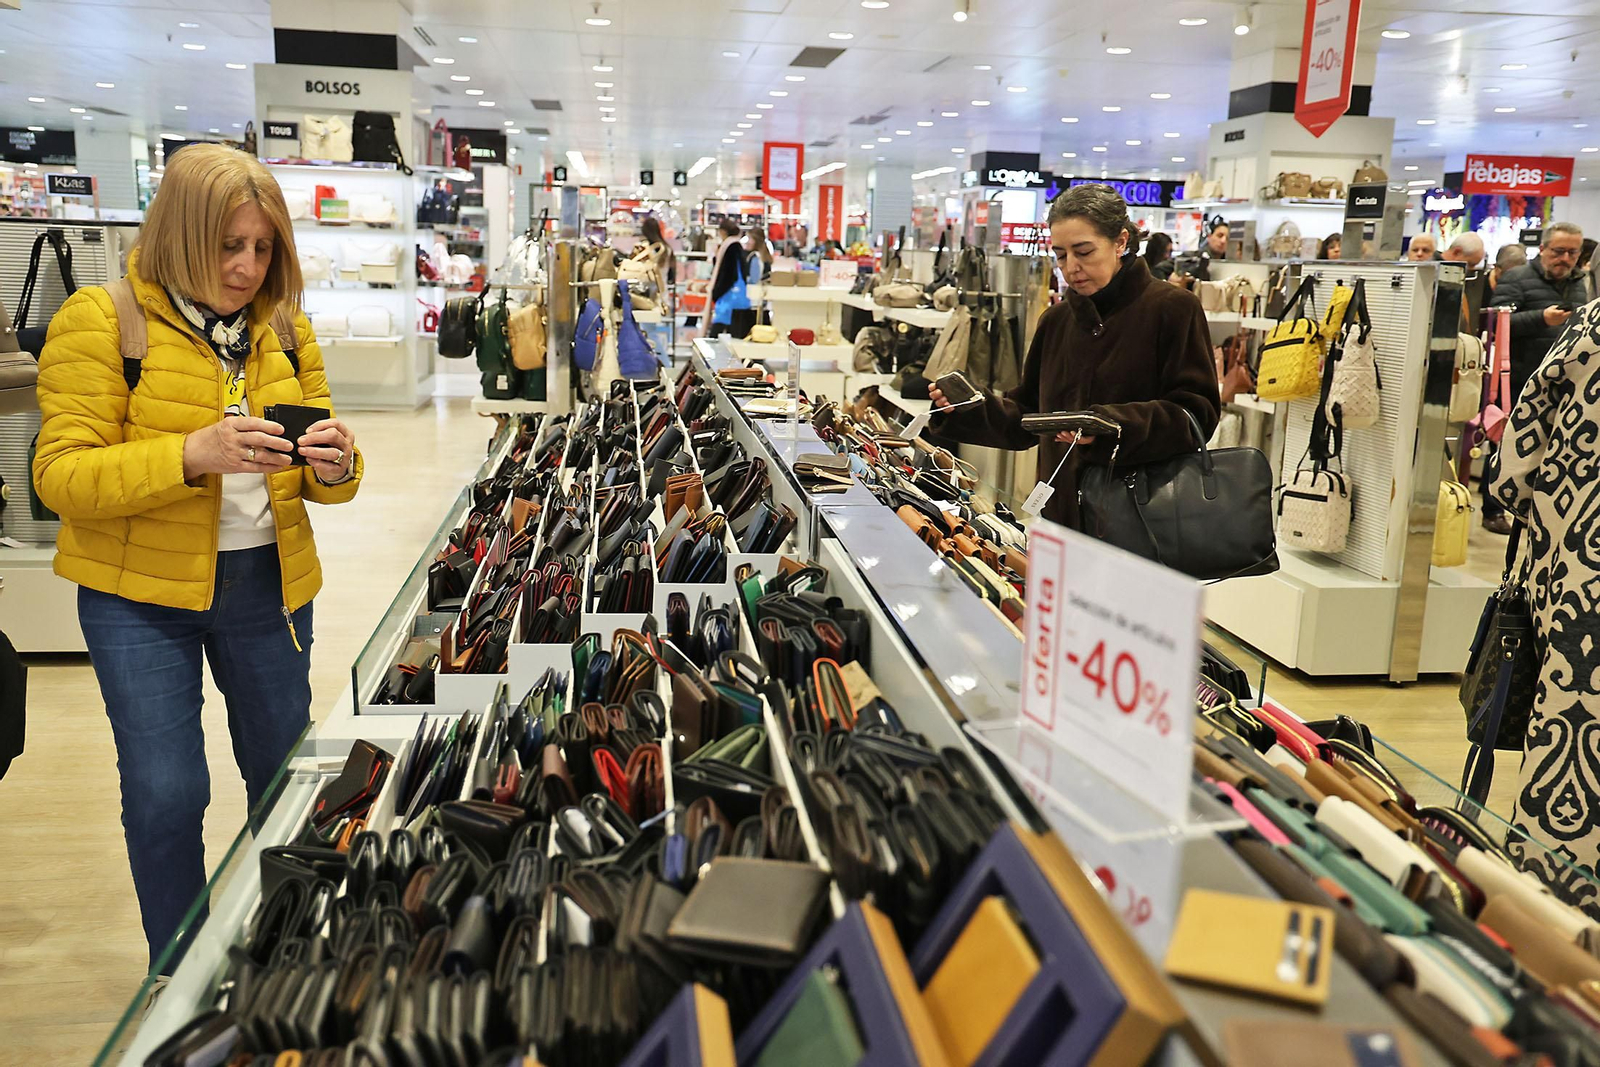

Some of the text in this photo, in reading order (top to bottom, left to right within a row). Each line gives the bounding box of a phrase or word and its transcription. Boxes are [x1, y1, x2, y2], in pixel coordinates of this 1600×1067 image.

[1311, 47, 1342, 72] -40%
[305, 80, 361, 95] BOLSOS
[1467, 162, 1543, 188] rebajas
[1468, 158, 1485, 167] Las
[1033, 577, 1054, 697] oferta
[1066, 639, 1172, 738] -40%
